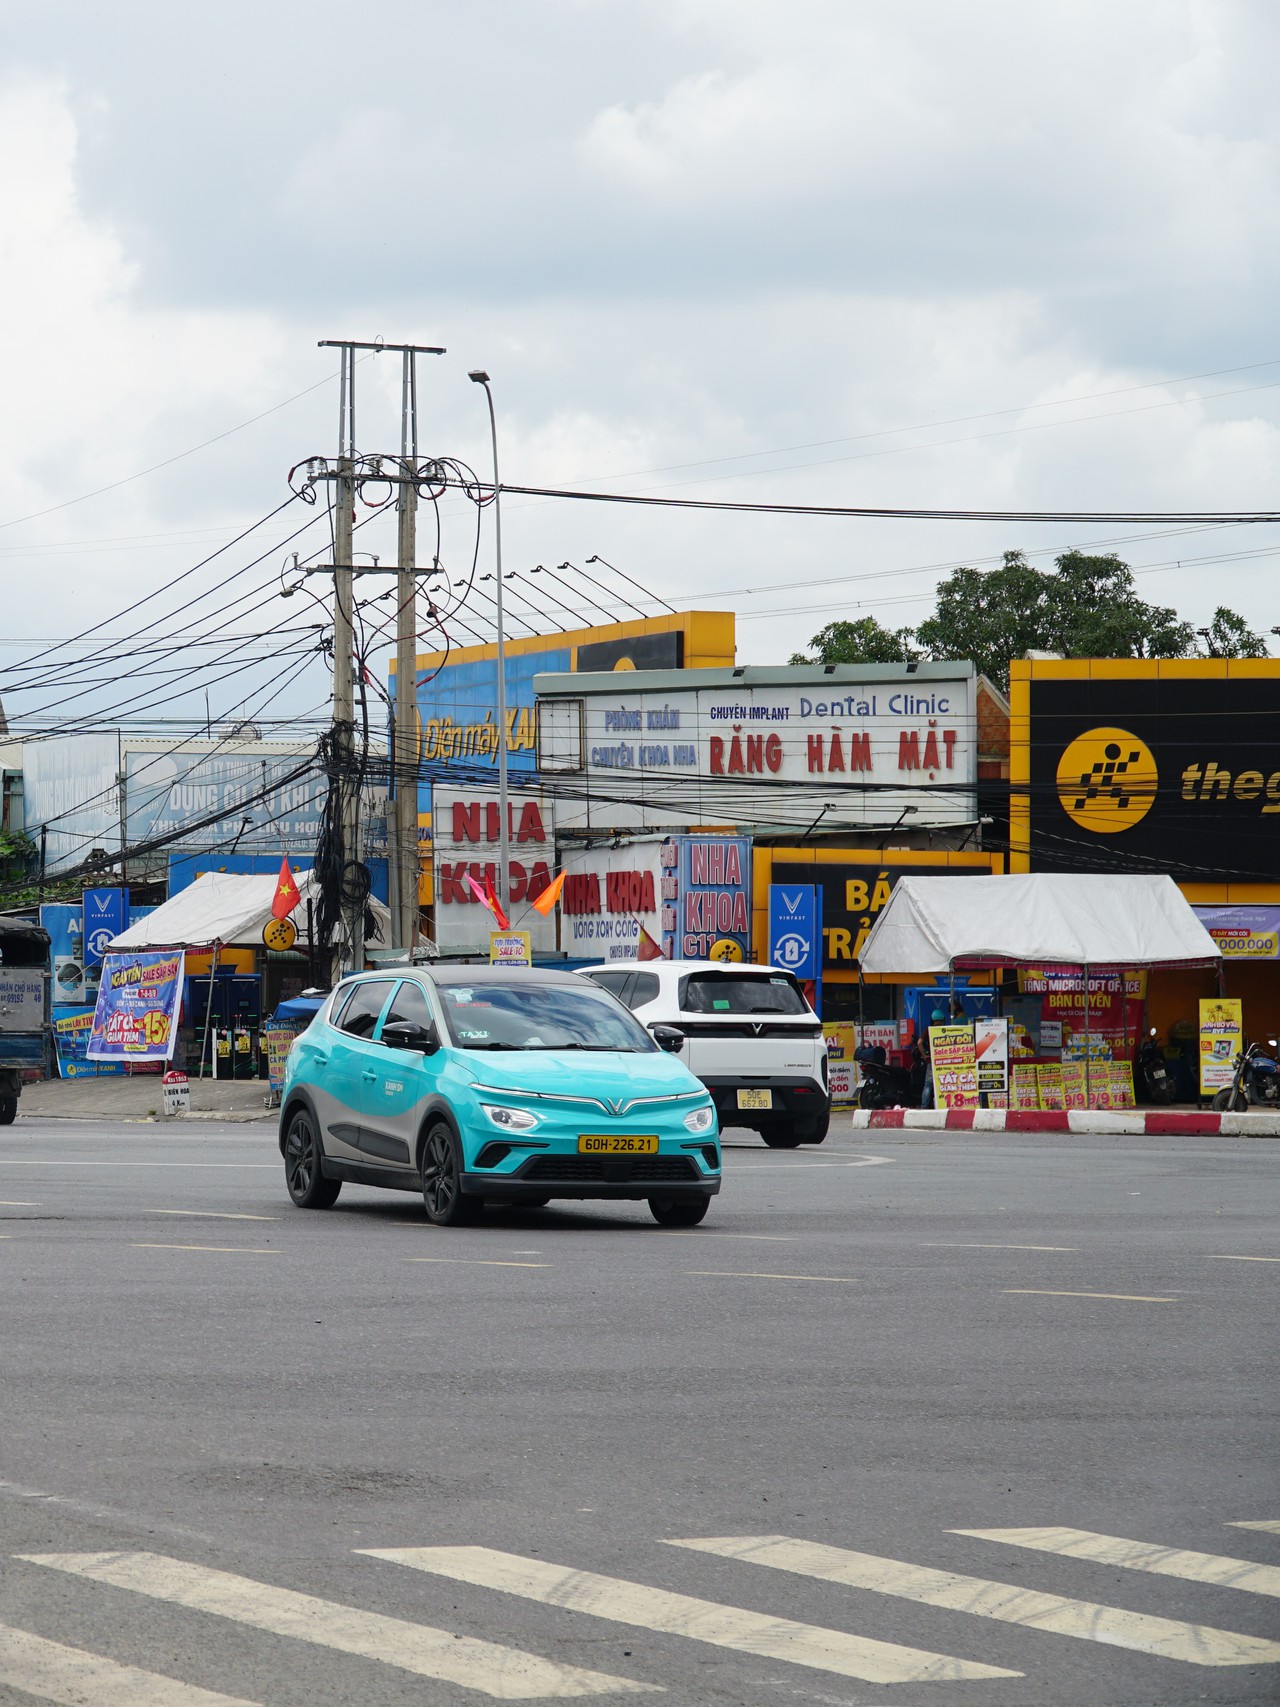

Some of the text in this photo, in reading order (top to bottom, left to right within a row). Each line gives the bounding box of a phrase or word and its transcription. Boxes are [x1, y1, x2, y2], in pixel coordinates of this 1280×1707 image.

[710, 703, 790, 720] CHUYÊN IMPLANT
[800, 694, 950, 718] Dental Clinic
[605, 704, 680, 731] PHÒNG KHÁM
[424, 714, 462, 766] Điện
[464, 711, 499, 764] máy
[592, 741, 697, 767] CHUYÊN KHOA NHA
[710, 719, 956, 781] RĂNG HÀM MẶT
[170, 784, 218, 816] DỤNG
[452, 801, 546, 842] NHA
[691, 843, 742, 885] NHA
[563, 870, 656, 914] NHA KHOA
[686, 891, 748, 933] KHOA
[596, 920, 613, 939] XOAY
[1024, 977, 1047, 993] TẶNG
[1048, 979, 1105, 992] MICROSOFT
[1049, 991, 1073, 1008] BẢN
[460, 1030, 488, 1039] TAXI
[857, 1026, 876, 1038] ĐỂM
[934, 1033, 972, 1046] NGÀY ĐÔI
[934, 1048, 948, 1056] Sale
[938, 1070, 975, 1083] TẤT CẢ
[741, 1100, 768, 1108] 662.80
[944, 1093, 965, 1107] 1.8
[1064, 1093, 1085, 1106] 9/9
[1088, 1092, 1110, 1105] 9/9
[584, 1138, 652, 1151] 60H-226.21
